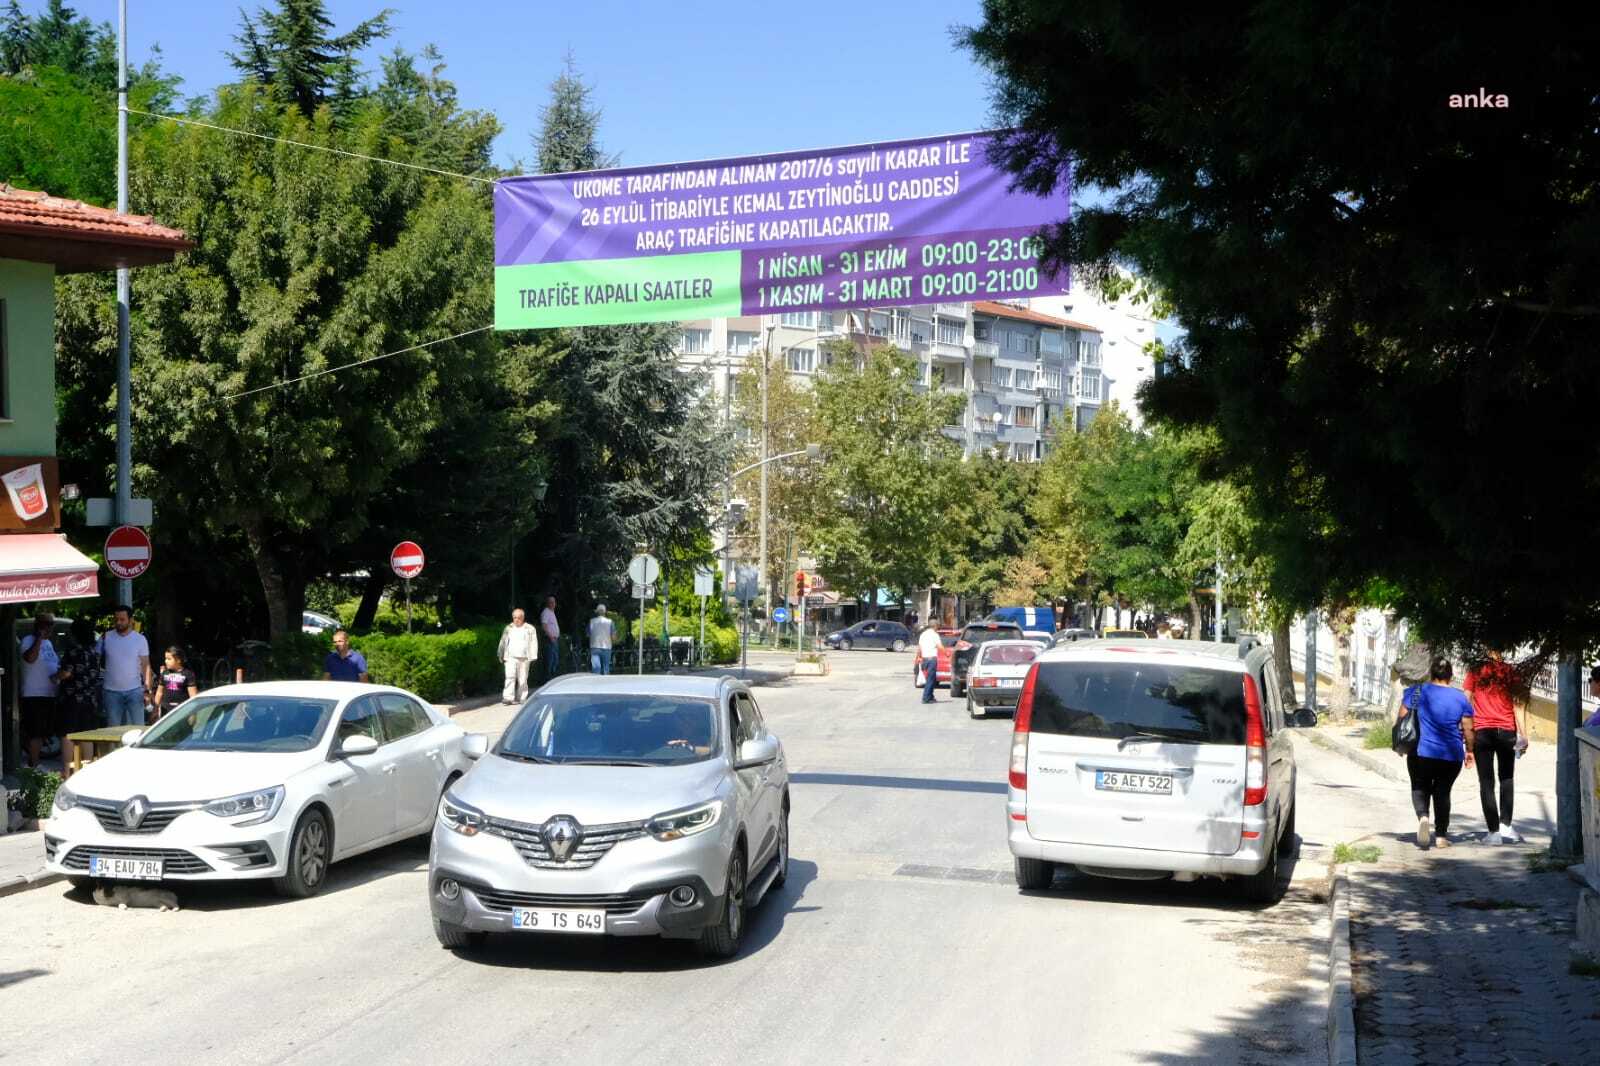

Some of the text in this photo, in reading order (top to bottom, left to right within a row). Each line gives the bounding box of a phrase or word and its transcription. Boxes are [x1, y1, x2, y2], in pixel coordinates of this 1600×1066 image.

[573, 141, 970, 199] UKOME TARAFINDAN ALINAN 2017/6 sayılı KARAR İLE
[581, 171, 959, 226] 26 EYLÜL İTİBARİYLE KEMAL ZEYTİNOĞLU CADDESİ
[636, 212, 894, 252] ARAÇ TRAFİĞİNE KAPATILACAKTIR.
[758, 258, 764, 279] 1
[769, 252, 823, 279] NİSAN
[840, 252, 859, 274] 31
[864, 244, 907, 272] EKİM
[519, 278, 713, 309] TRAFİĞE KAPALI SAATLER
[759, 287, 765, 308] 1
[770, 283, 824, 308] KASIM
[839, 280, 857, 302] 31
[862, 276, 912, 301] MART
[922, 267, 1038, 297] 09:00-21:00
[1104, 772, 1118, 785] 26
[1121, 774, 1145, 787] AEY
[1148, 776, 1171, 790] 522
[97, 860, 159, 874] 34 EAU 784
[523, 911, 602, 929] 26 TS 649
